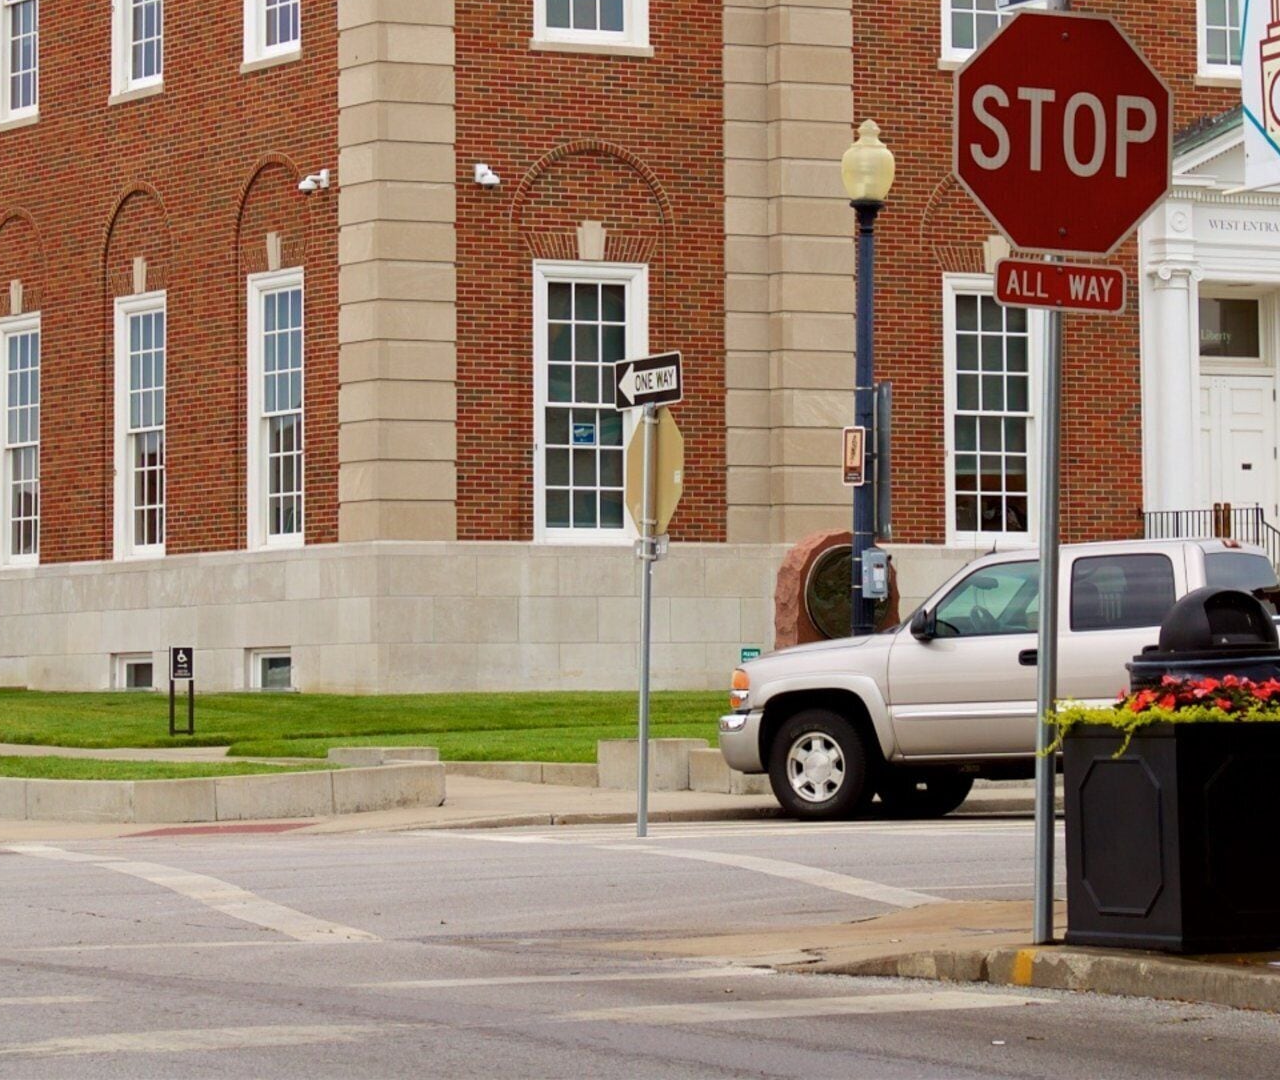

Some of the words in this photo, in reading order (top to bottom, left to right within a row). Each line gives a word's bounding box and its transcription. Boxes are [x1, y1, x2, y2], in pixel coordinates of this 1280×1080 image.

[970, 84, 1158, 178] STOP
[1208, 218, 1240, 232] WEST
[1005, 269, 1049, 298] ALL
[1068, 273, 1114, 303] WAY
[635, 372, 654, 392] ONE
[656, 368, 675, 388] WAY
